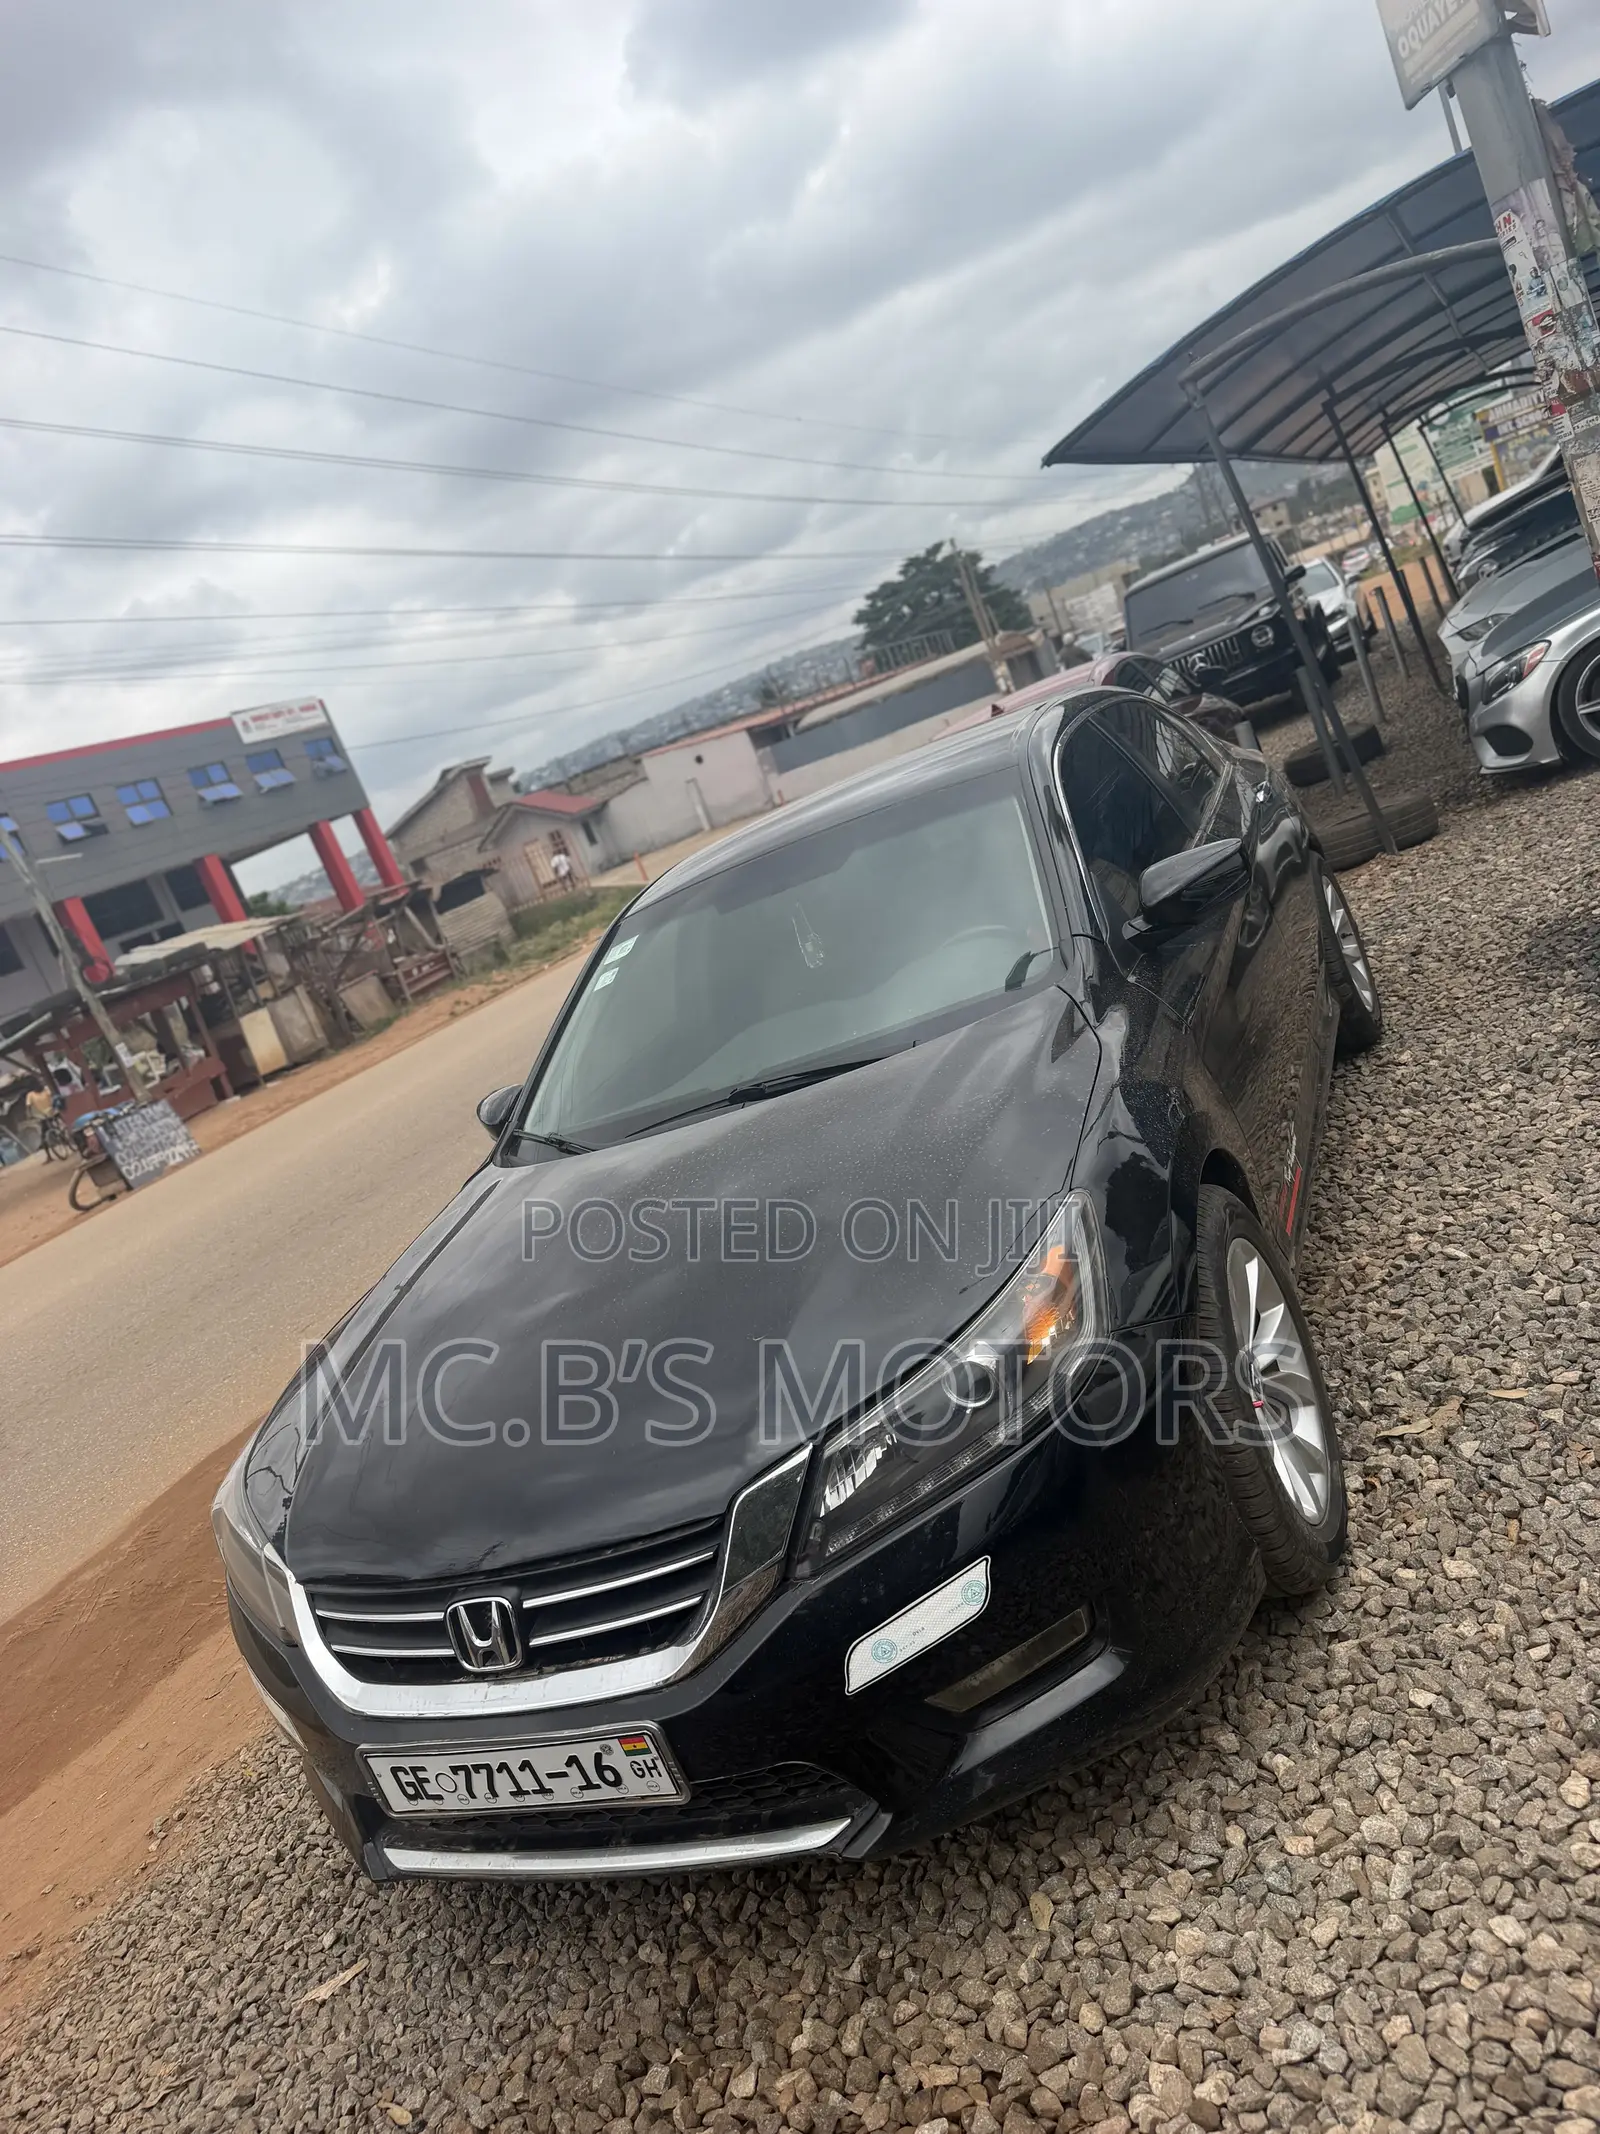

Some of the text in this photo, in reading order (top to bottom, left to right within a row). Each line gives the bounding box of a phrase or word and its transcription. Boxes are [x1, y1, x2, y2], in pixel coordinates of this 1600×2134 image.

[390, 1751, 623, 1801] GE 7711-16
[629, 1758, 663, 1779] GH
